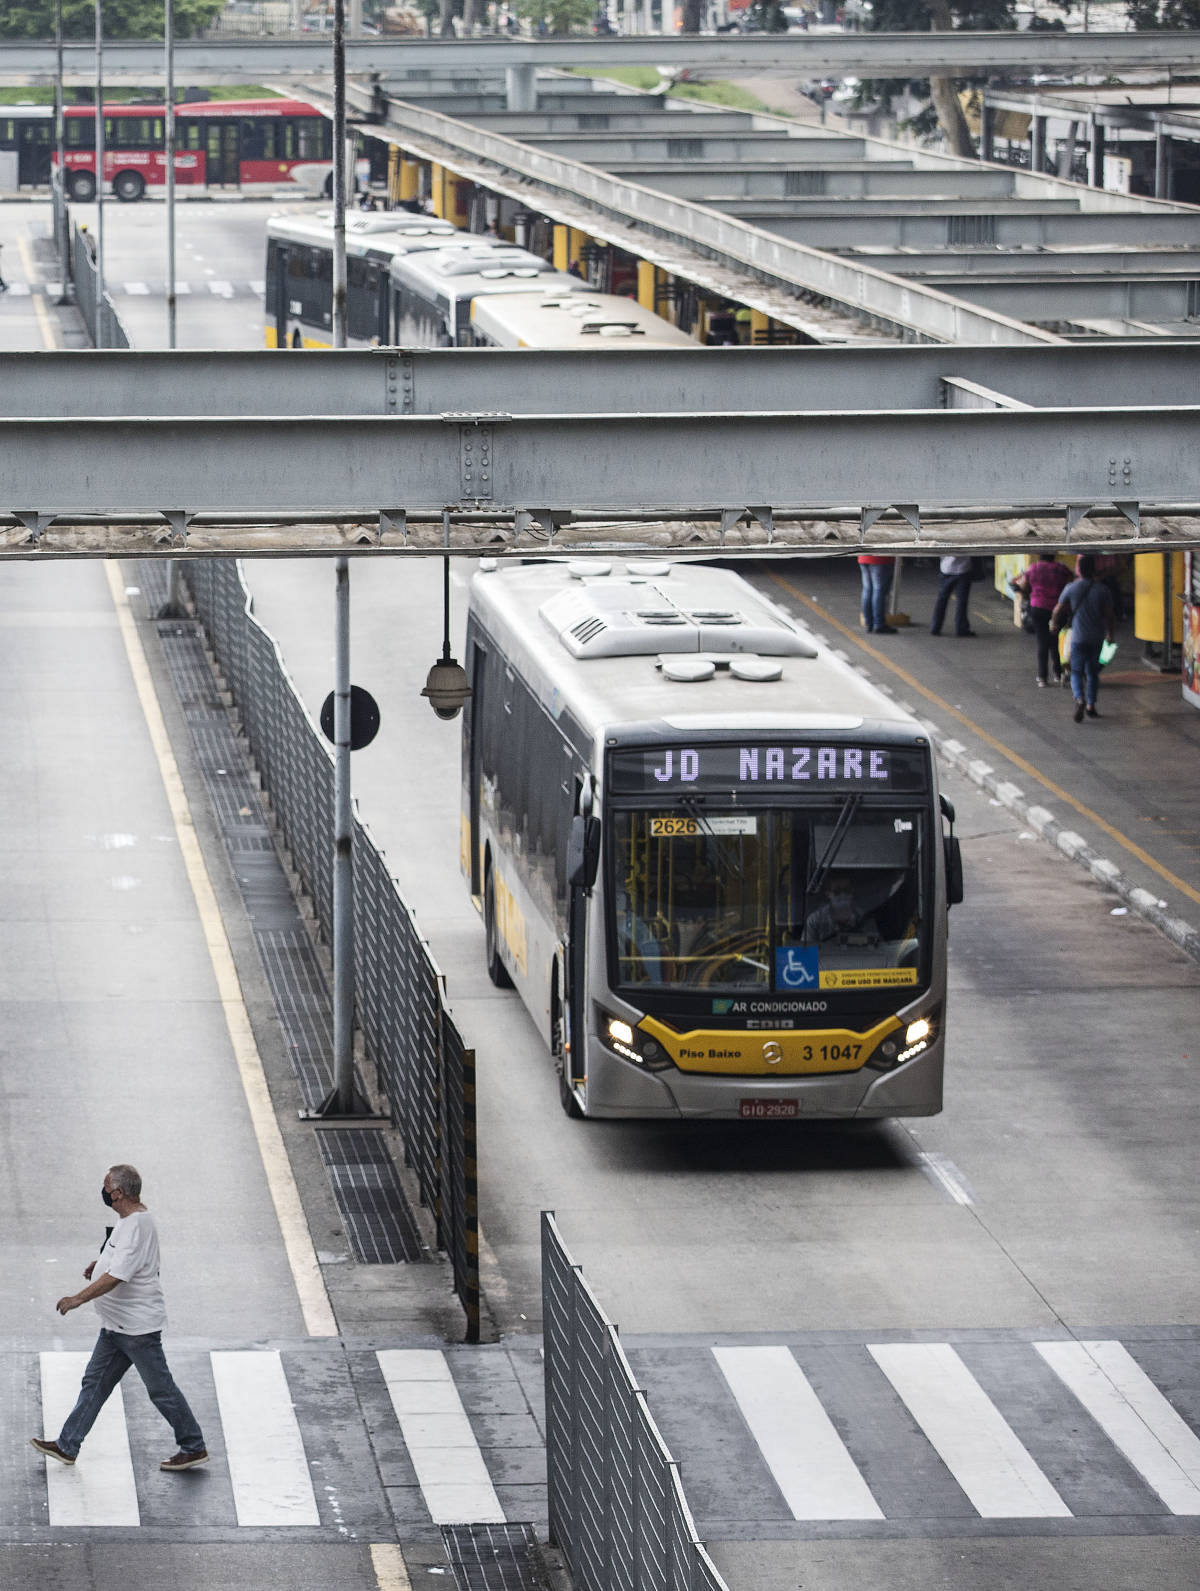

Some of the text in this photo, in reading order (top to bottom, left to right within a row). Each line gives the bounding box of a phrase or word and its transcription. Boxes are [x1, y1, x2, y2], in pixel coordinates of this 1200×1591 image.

[654, 747, 889, 782] JD NAZARE
[653, 819, 697, 834] 2626
[732, 1001, 827, 1012] AR CONDICIONADO
[679, 1048, 741, 1058] Piso Baixo
[802, 1044, 863, 1060] 3 1047
